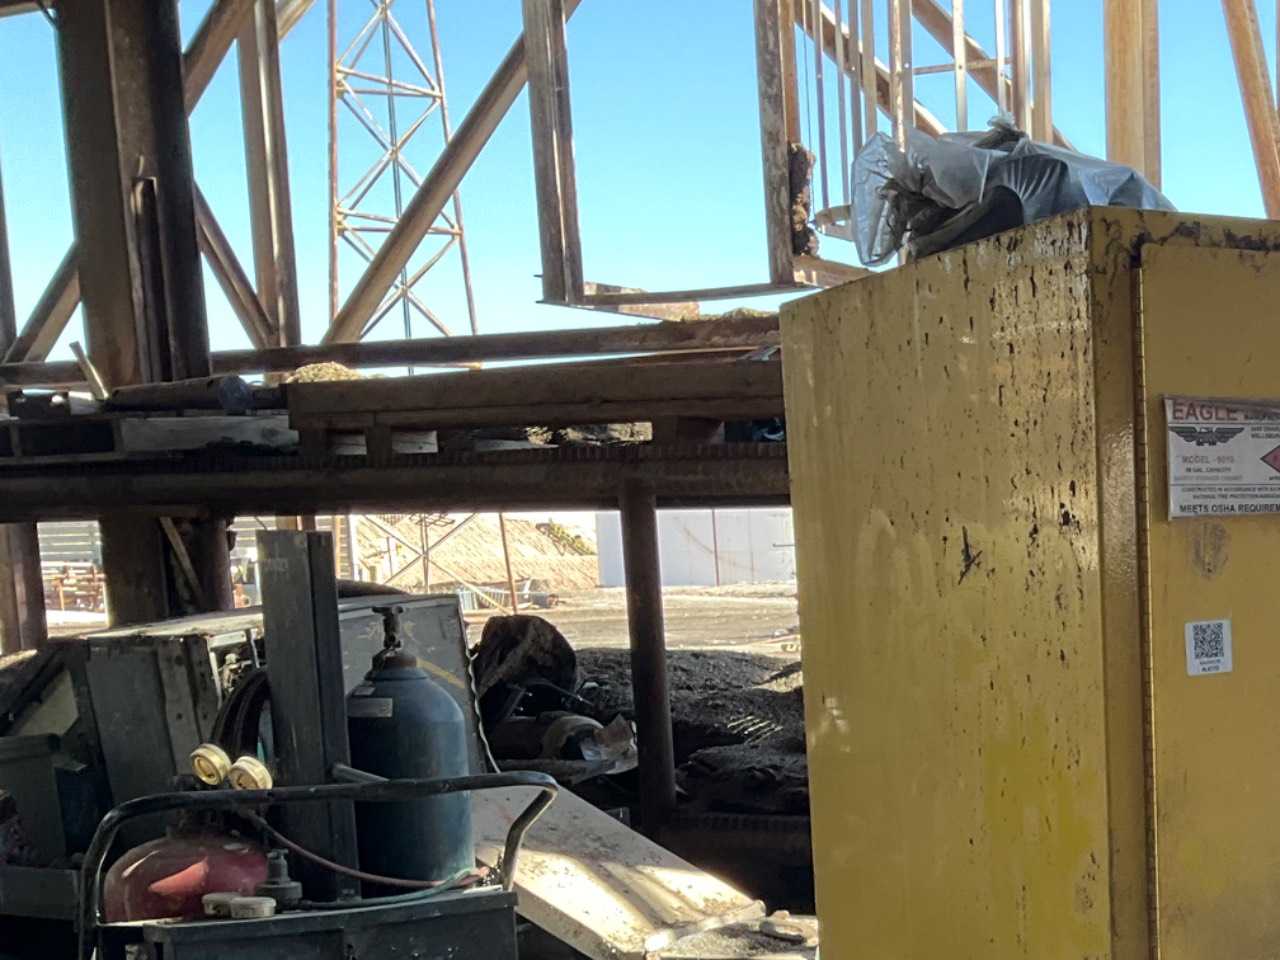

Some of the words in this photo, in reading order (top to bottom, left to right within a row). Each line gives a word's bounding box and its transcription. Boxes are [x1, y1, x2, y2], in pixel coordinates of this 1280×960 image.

[1172, 402, 1238, 421] EAGLE
[1180, 504, 1209, 513] MEETS
[1211, 503, 1235, 512] OSHA
